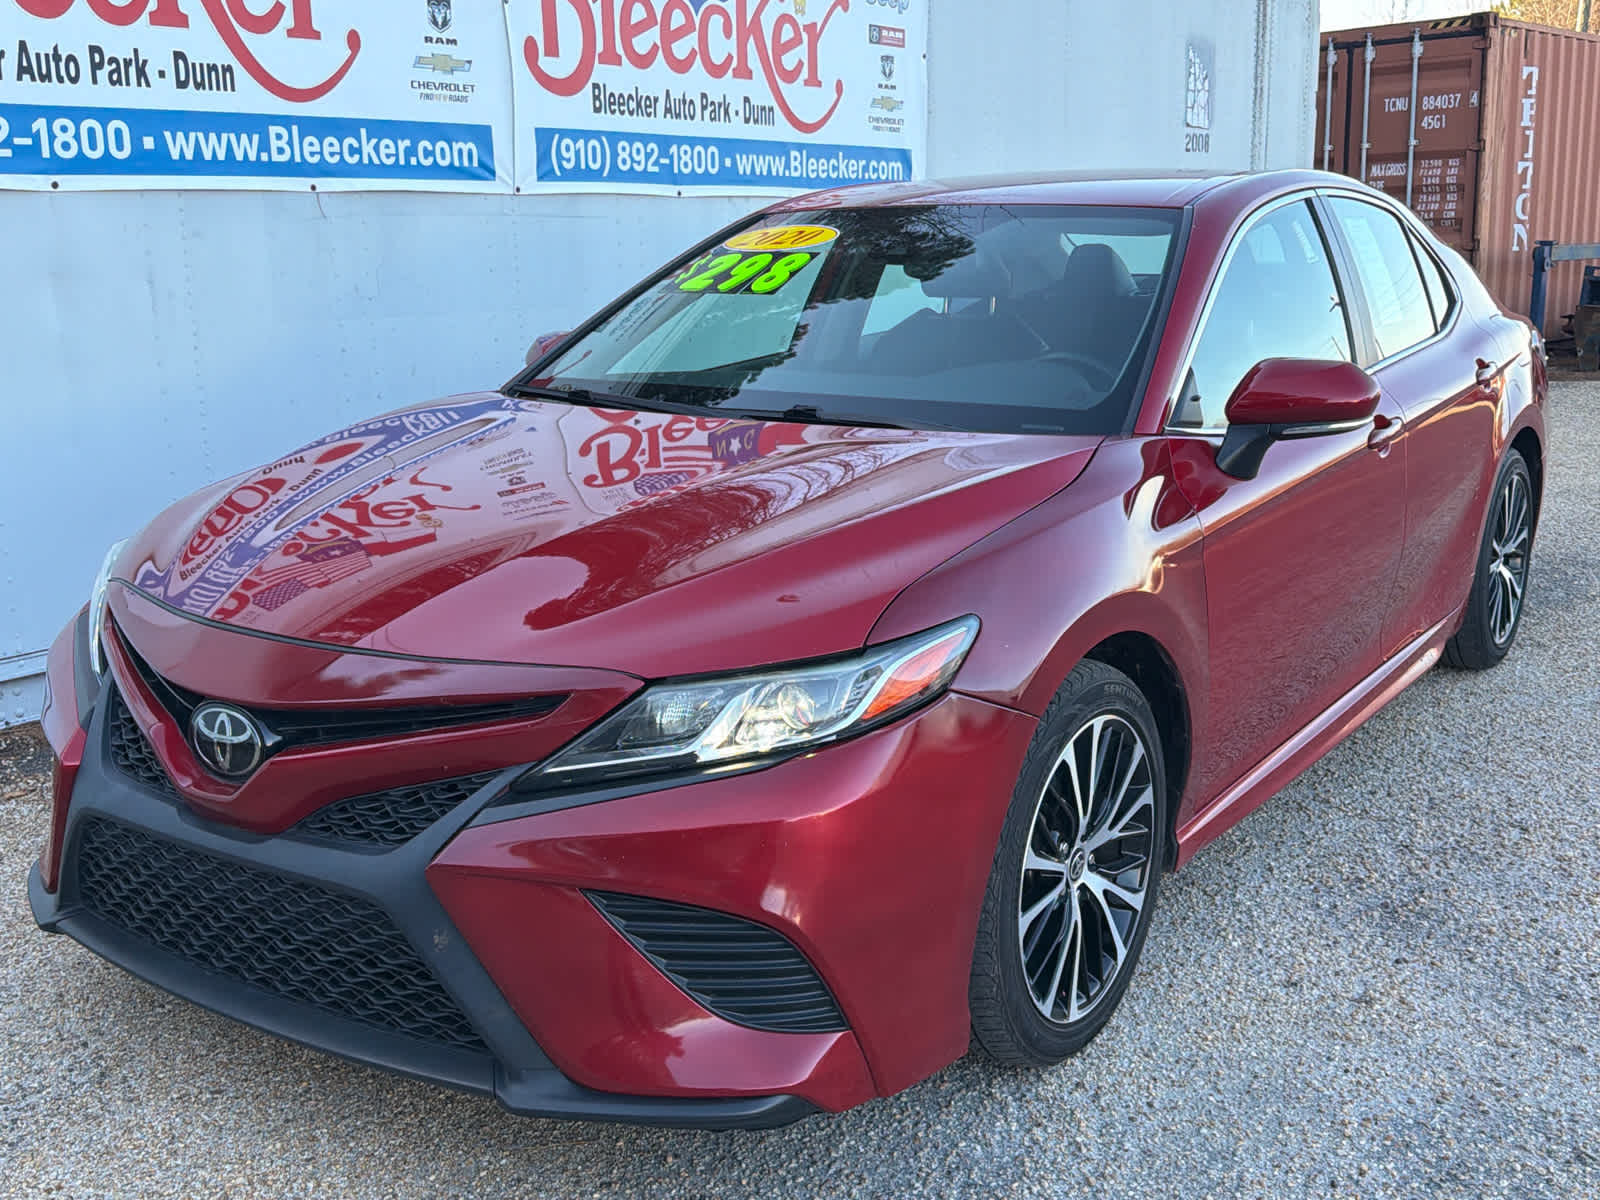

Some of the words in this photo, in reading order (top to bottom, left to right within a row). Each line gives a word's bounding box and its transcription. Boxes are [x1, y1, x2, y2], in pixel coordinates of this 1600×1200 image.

[424, 36, 458, 46] RAM
[16, 40, 80, 84] Auto
[88, 45, 151, 88] Park
[173, 50, 236, 92] Dunn
[410, 80, 476, 93] CHEVROLET
[591, 83, 659, 118] Bleecker
[663, 89, 696, 121] Auto
[700, 92, 732, 123] Park
[743, 96, 775, 126] Dunn
[1384, 97, 1409, 113] TCNU
[1422, 93, 1462, 111] 884037
[163, 125, 479, 168] www.Bleecker.com
[551, 134, 611, 177] (910)
[617, 140, 719, 175] 892-1800
[736, 150, 903, 181] www.Bleecker.com
[737, 229, 825, 247] 2020
[674, 252, 812, 293] $298
